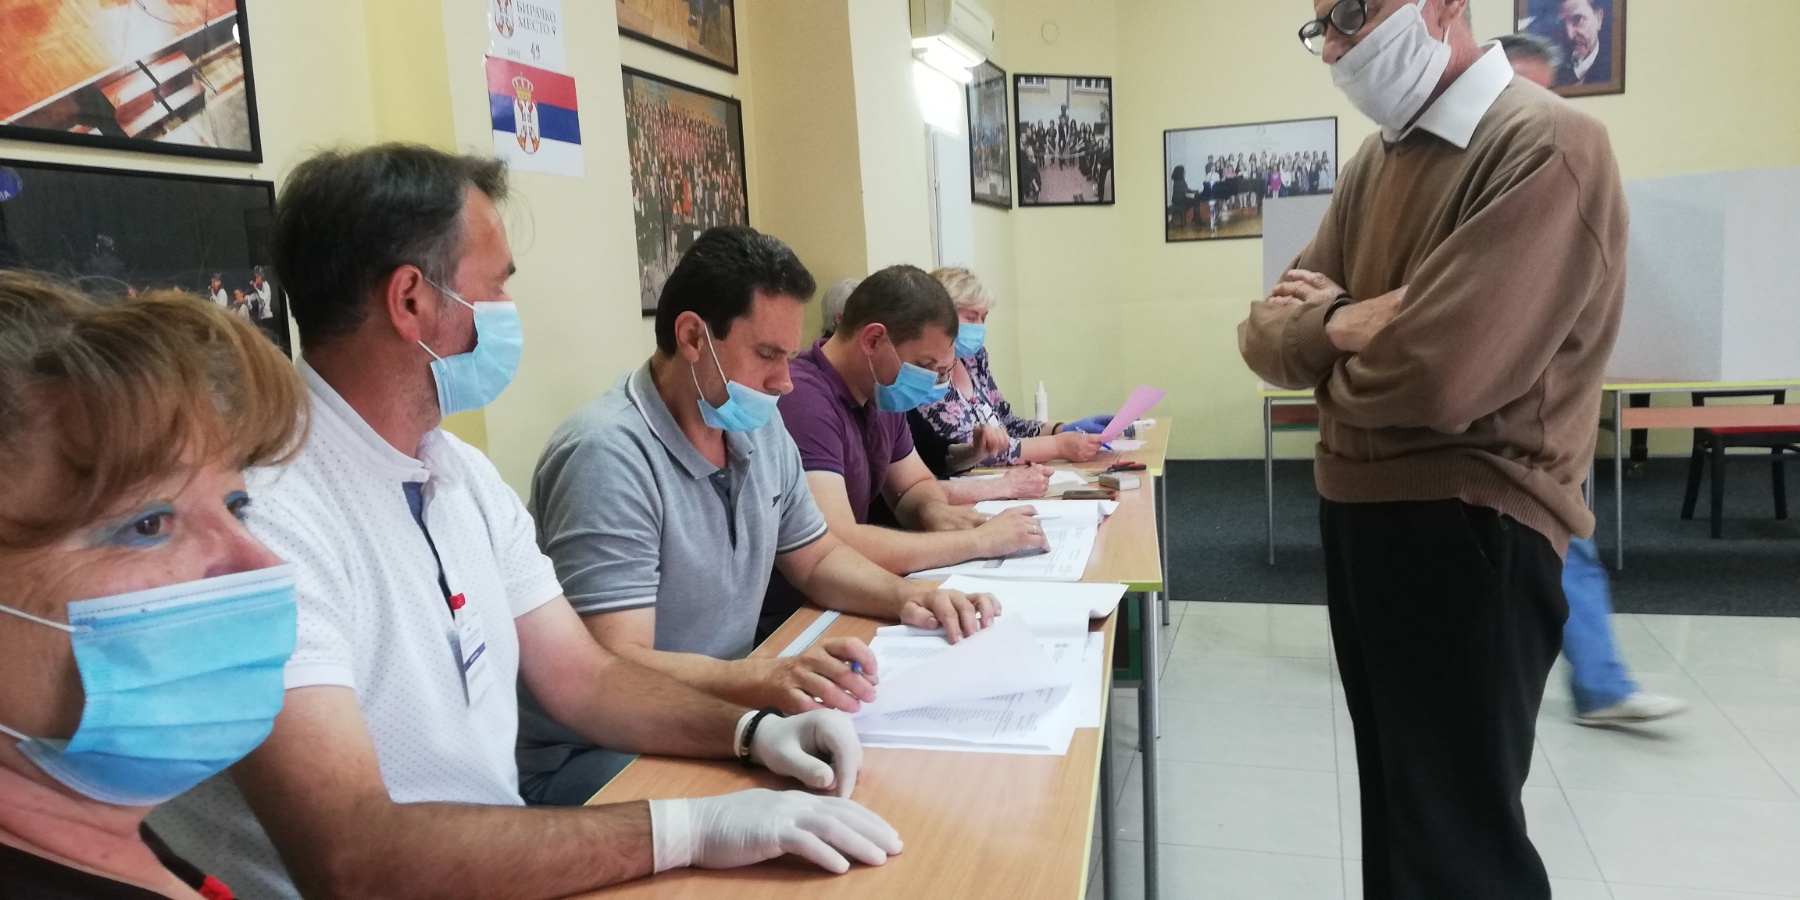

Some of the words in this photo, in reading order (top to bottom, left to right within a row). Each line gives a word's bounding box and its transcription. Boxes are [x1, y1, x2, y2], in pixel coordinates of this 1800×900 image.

[517, 1, 556, 22] БИРАЧКО
[518, 16, 550, 35] МЕСТО
[530, 42, 540, 60] 49
